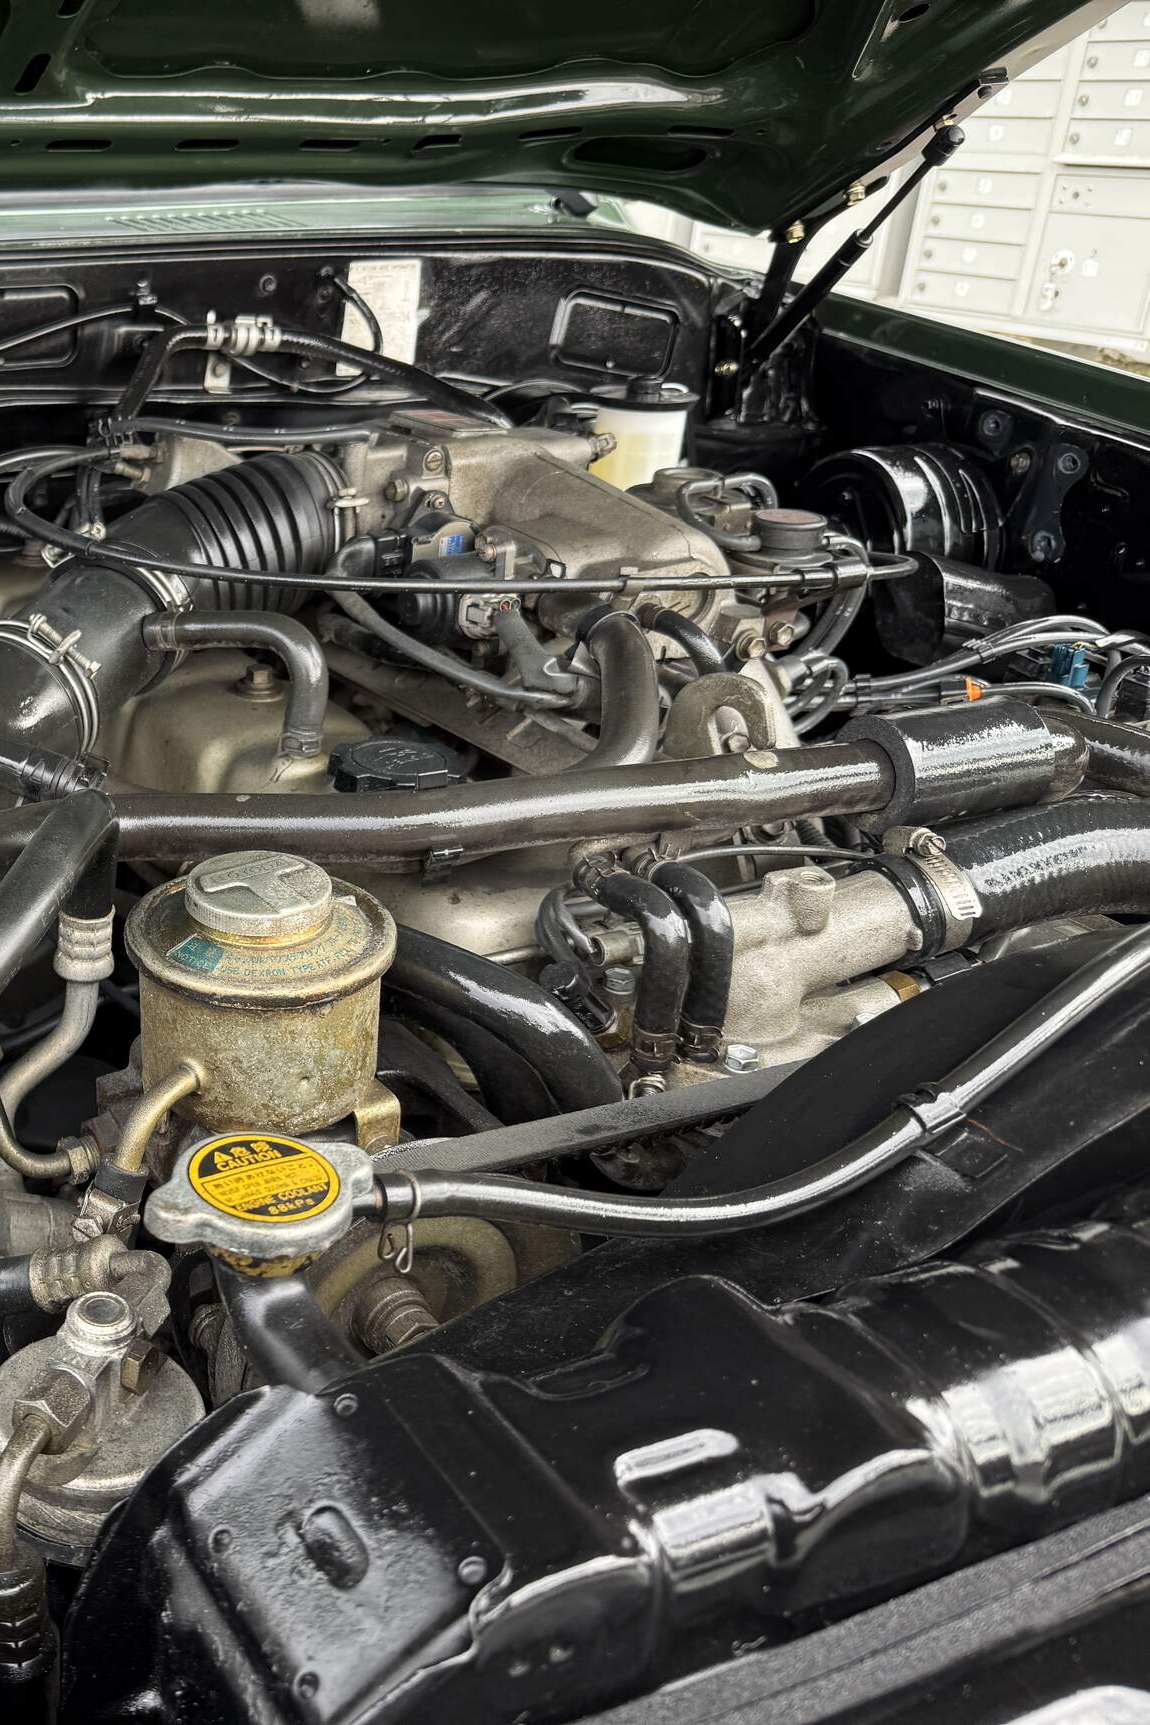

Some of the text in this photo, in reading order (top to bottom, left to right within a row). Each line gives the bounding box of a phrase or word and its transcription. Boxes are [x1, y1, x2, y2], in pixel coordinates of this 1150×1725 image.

[176, 950, 211, 971] NOTICE
[244, 967, 286, 977] DEXRON
[291, 961, 316, 975] TYPE
[216, 1150, 282, 1172] CAUTION
[236, 1195, 275, 1212] ENGINE
[277, 1183, 328, 1201] COOLANT
